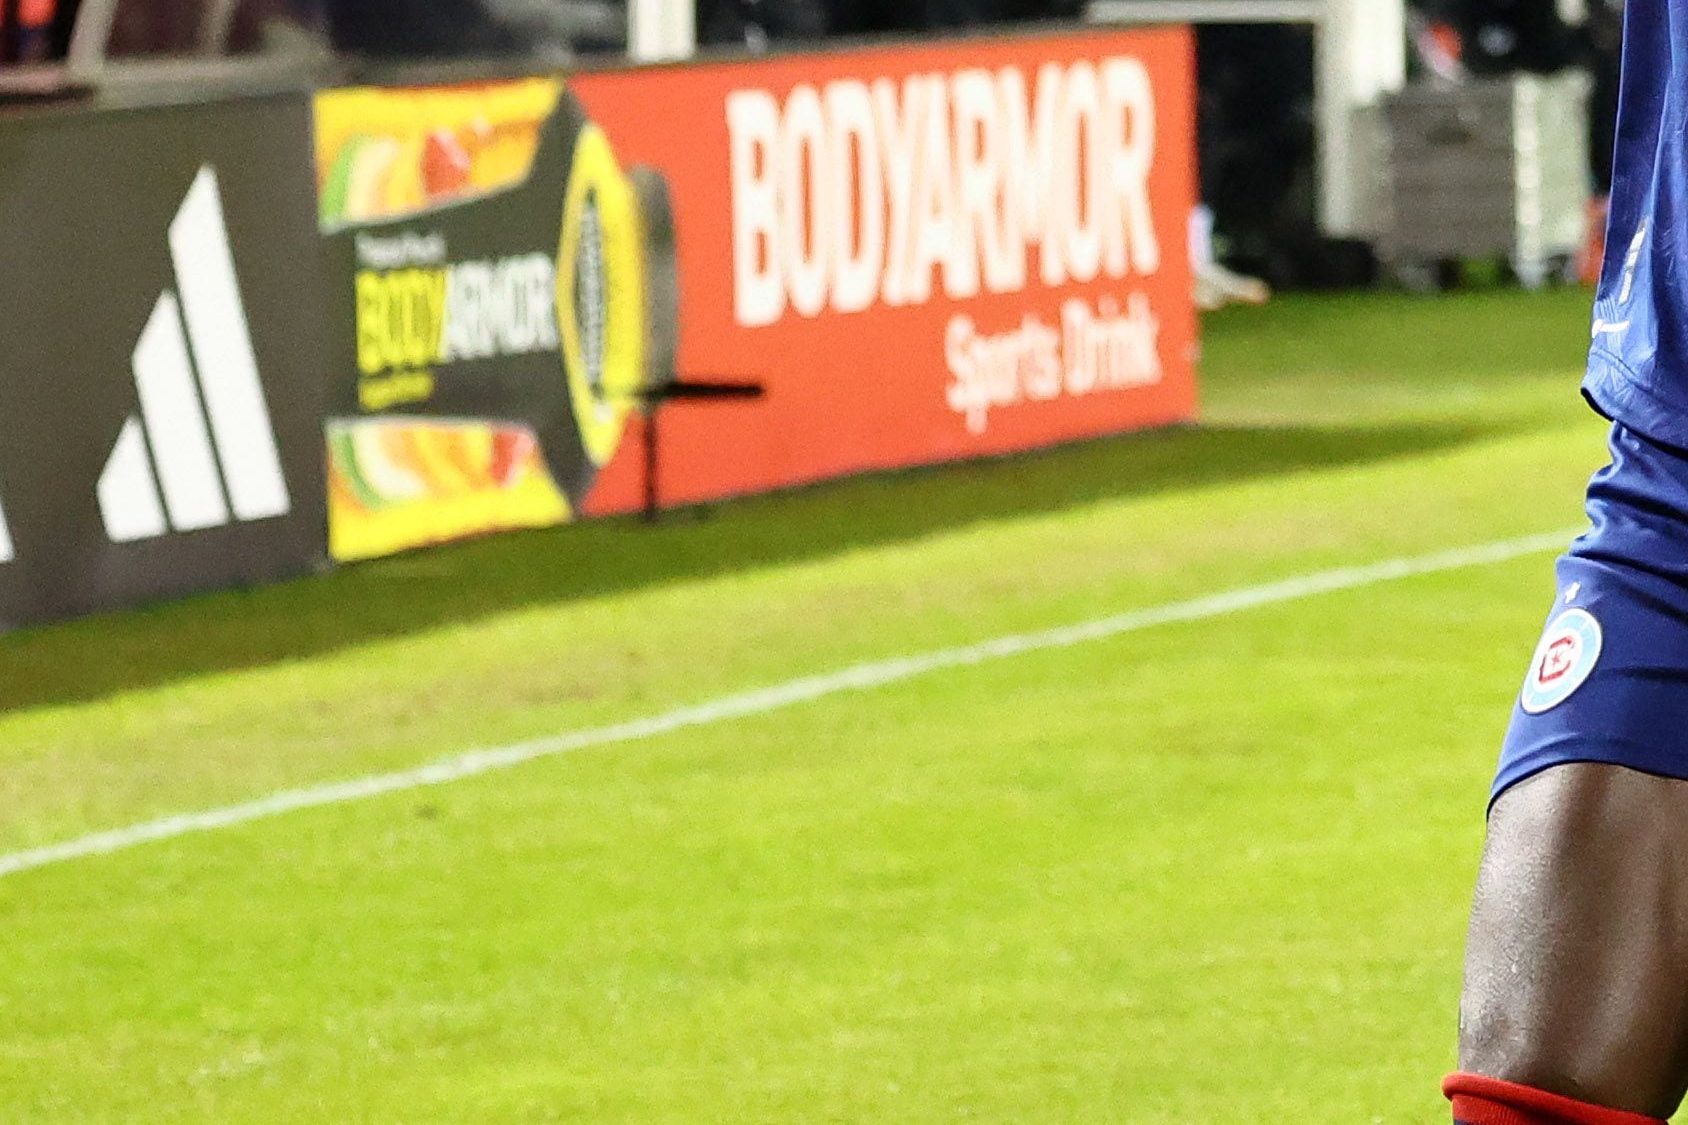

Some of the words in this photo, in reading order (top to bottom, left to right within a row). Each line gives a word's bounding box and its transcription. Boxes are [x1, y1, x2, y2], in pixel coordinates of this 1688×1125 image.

[725, 56, 1159, 327] BODYARMOR
[356, 252, 559, 372] BODYARMOR
[945, 313, 1062, 435] Sports
[1060, 291, 1163, 395] Drink
